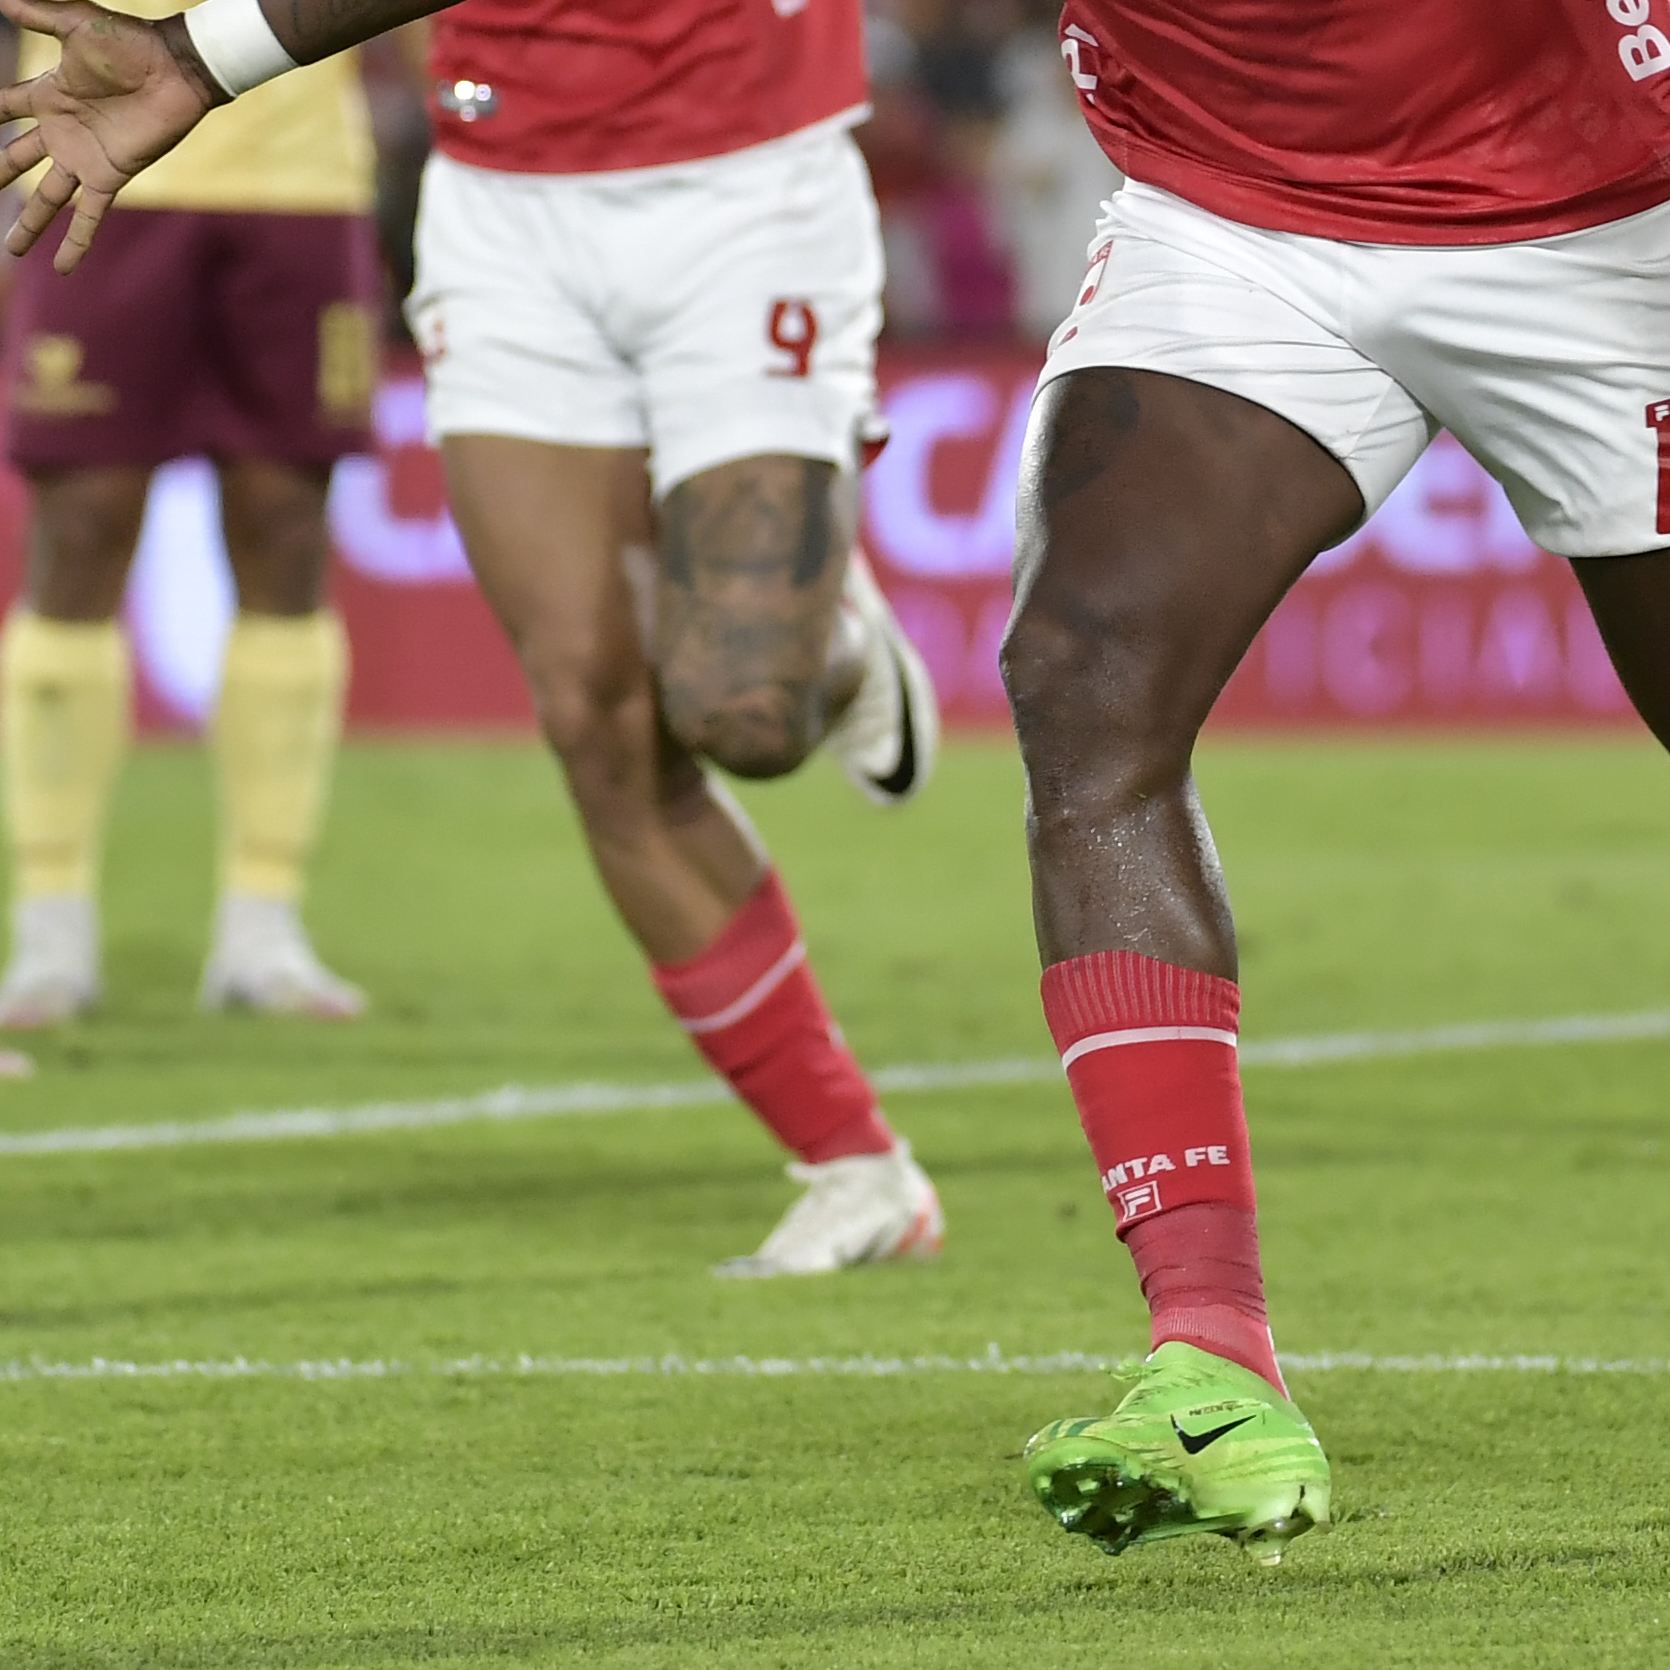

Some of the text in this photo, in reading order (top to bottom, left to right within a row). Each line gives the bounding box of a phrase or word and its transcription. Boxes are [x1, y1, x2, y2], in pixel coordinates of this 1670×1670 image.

[763, 297, 817, 377] 9
[1101, 1144, 1231, 1194] ANTA FE
